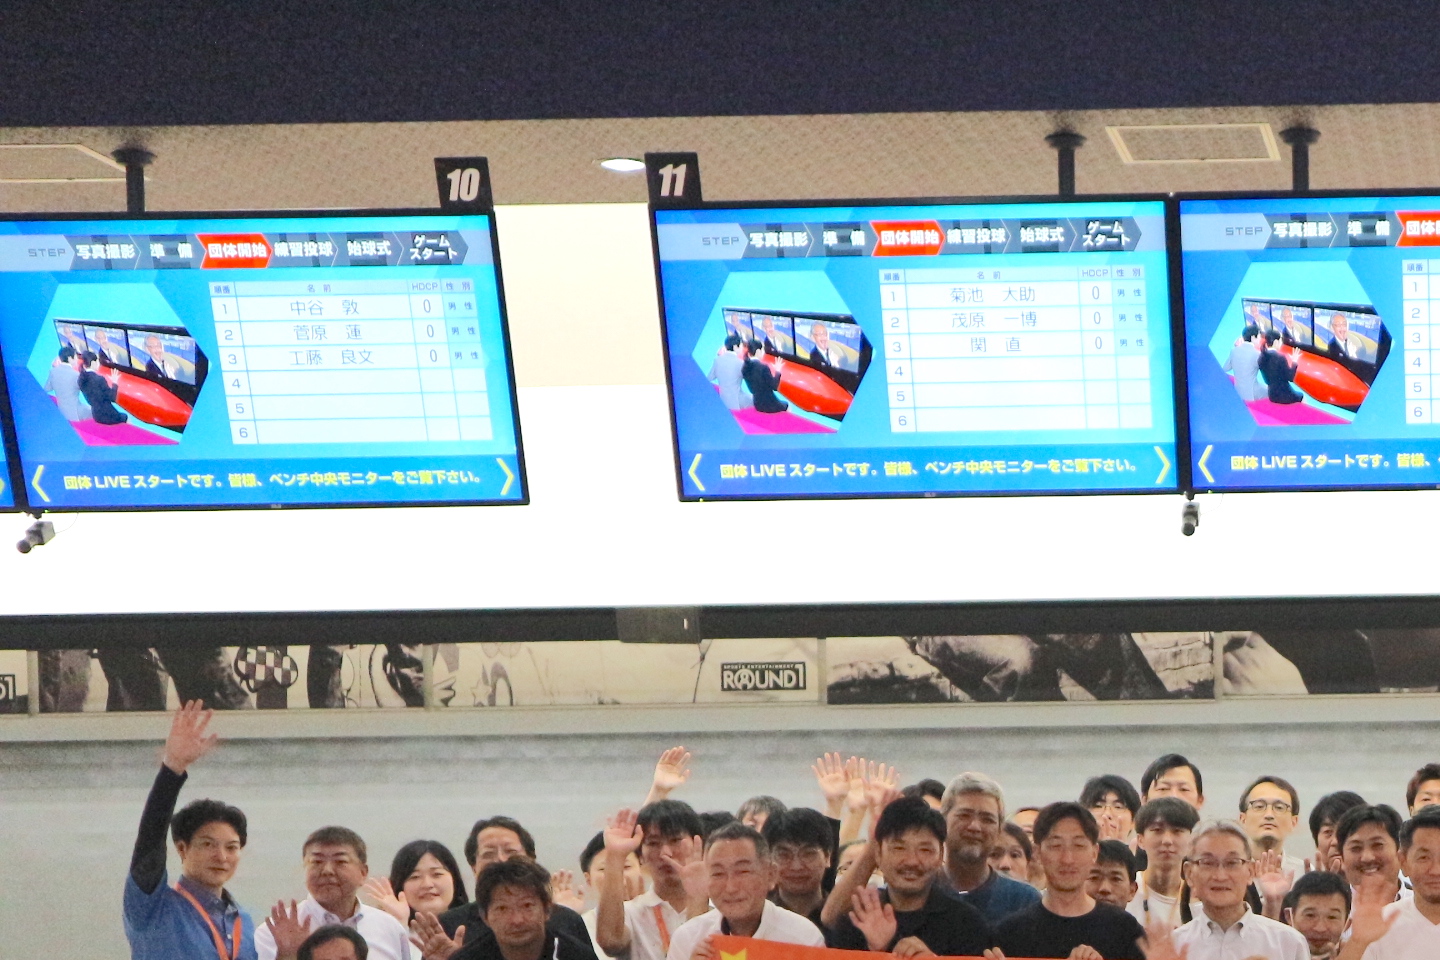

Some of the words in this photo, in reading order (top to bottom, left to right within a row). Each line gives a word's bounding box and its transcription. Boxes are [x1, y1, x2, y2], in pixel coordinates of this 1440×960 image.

[447, 168, 480, 201] 10
[658, 163, 688, 197] 11
[1087, 220, 1125, 235] ゲーム
[1226, 227, 1262, 235] STEP
[1274, 222, 1332, 237] 写真撮影
[413, 233, 451, 248] ゲーム
[702, 236, 739, 245] STEP
[749, 231, 809, 247] 写真撮影
[880, 229, 940, 245] 団体開始
[946, 227, 1006, 244] 練習投球
[1020, 226, 1065, 243] 始球式
[1081, 232, 1131, 247] スタート
[28, 248, 66, 257] STEP
[75, 243, 136, 259] 写真撮影
[207, 242, 268, 258] 団体開始
[273, 240, 334, 257] 練習投球
[346, 240, 392, 256] 始球式
[408, 246, 459, 260] スタート
[1082, 269, 1109, 277] HDCP
[411, 282, 439, 290] HDCP
[1413, 282, 1417, 292] 1
[890, 291, 896, 302] 1
[949, 286, 983, 303] 菊池
[1002, 285, 1035, 302] 大助
[1092, 286, 1101, 301] 0
[222, 303, 228, 314] 1
[289, 299, 325, 315] 中谷
[423, 299, 432, 314] 0
[1412, 308, 1420, 318] 2
[891, 317, 900, 328] 2
[1003, 311, 1037, 328] 一博
[1093, 311, 1102, 325] 0
[224, 329, 234, 340] 2
[426, 324, 435, 338] 0
[1412, 332, 1420, 343] 3
[892, 341, 901, 353] 3
[970, 337, 987, 354] 関
[1005, 336, 1021, 353] 直
[1095, 337, 1103, 349] 0
[227, 353, 237, 365] 3
[288, 350, 323, 366] 工藤
[339, 349, 374, 365] 良文
[429, 349, 439, 362] 0
[1413, 357, 1421, 367] 4
[894, 366, 904, 376] 4
[231, 378, 241, 388] 4
[1414, 382, 1422, 392] 5
[897, 390, 906, 401] 5
[235, 402, 246, 413] 5
[1414, 407, 1422, 417] 6
[898, 415, 907, 426] 6
[239, 427, 249, 438] 6
